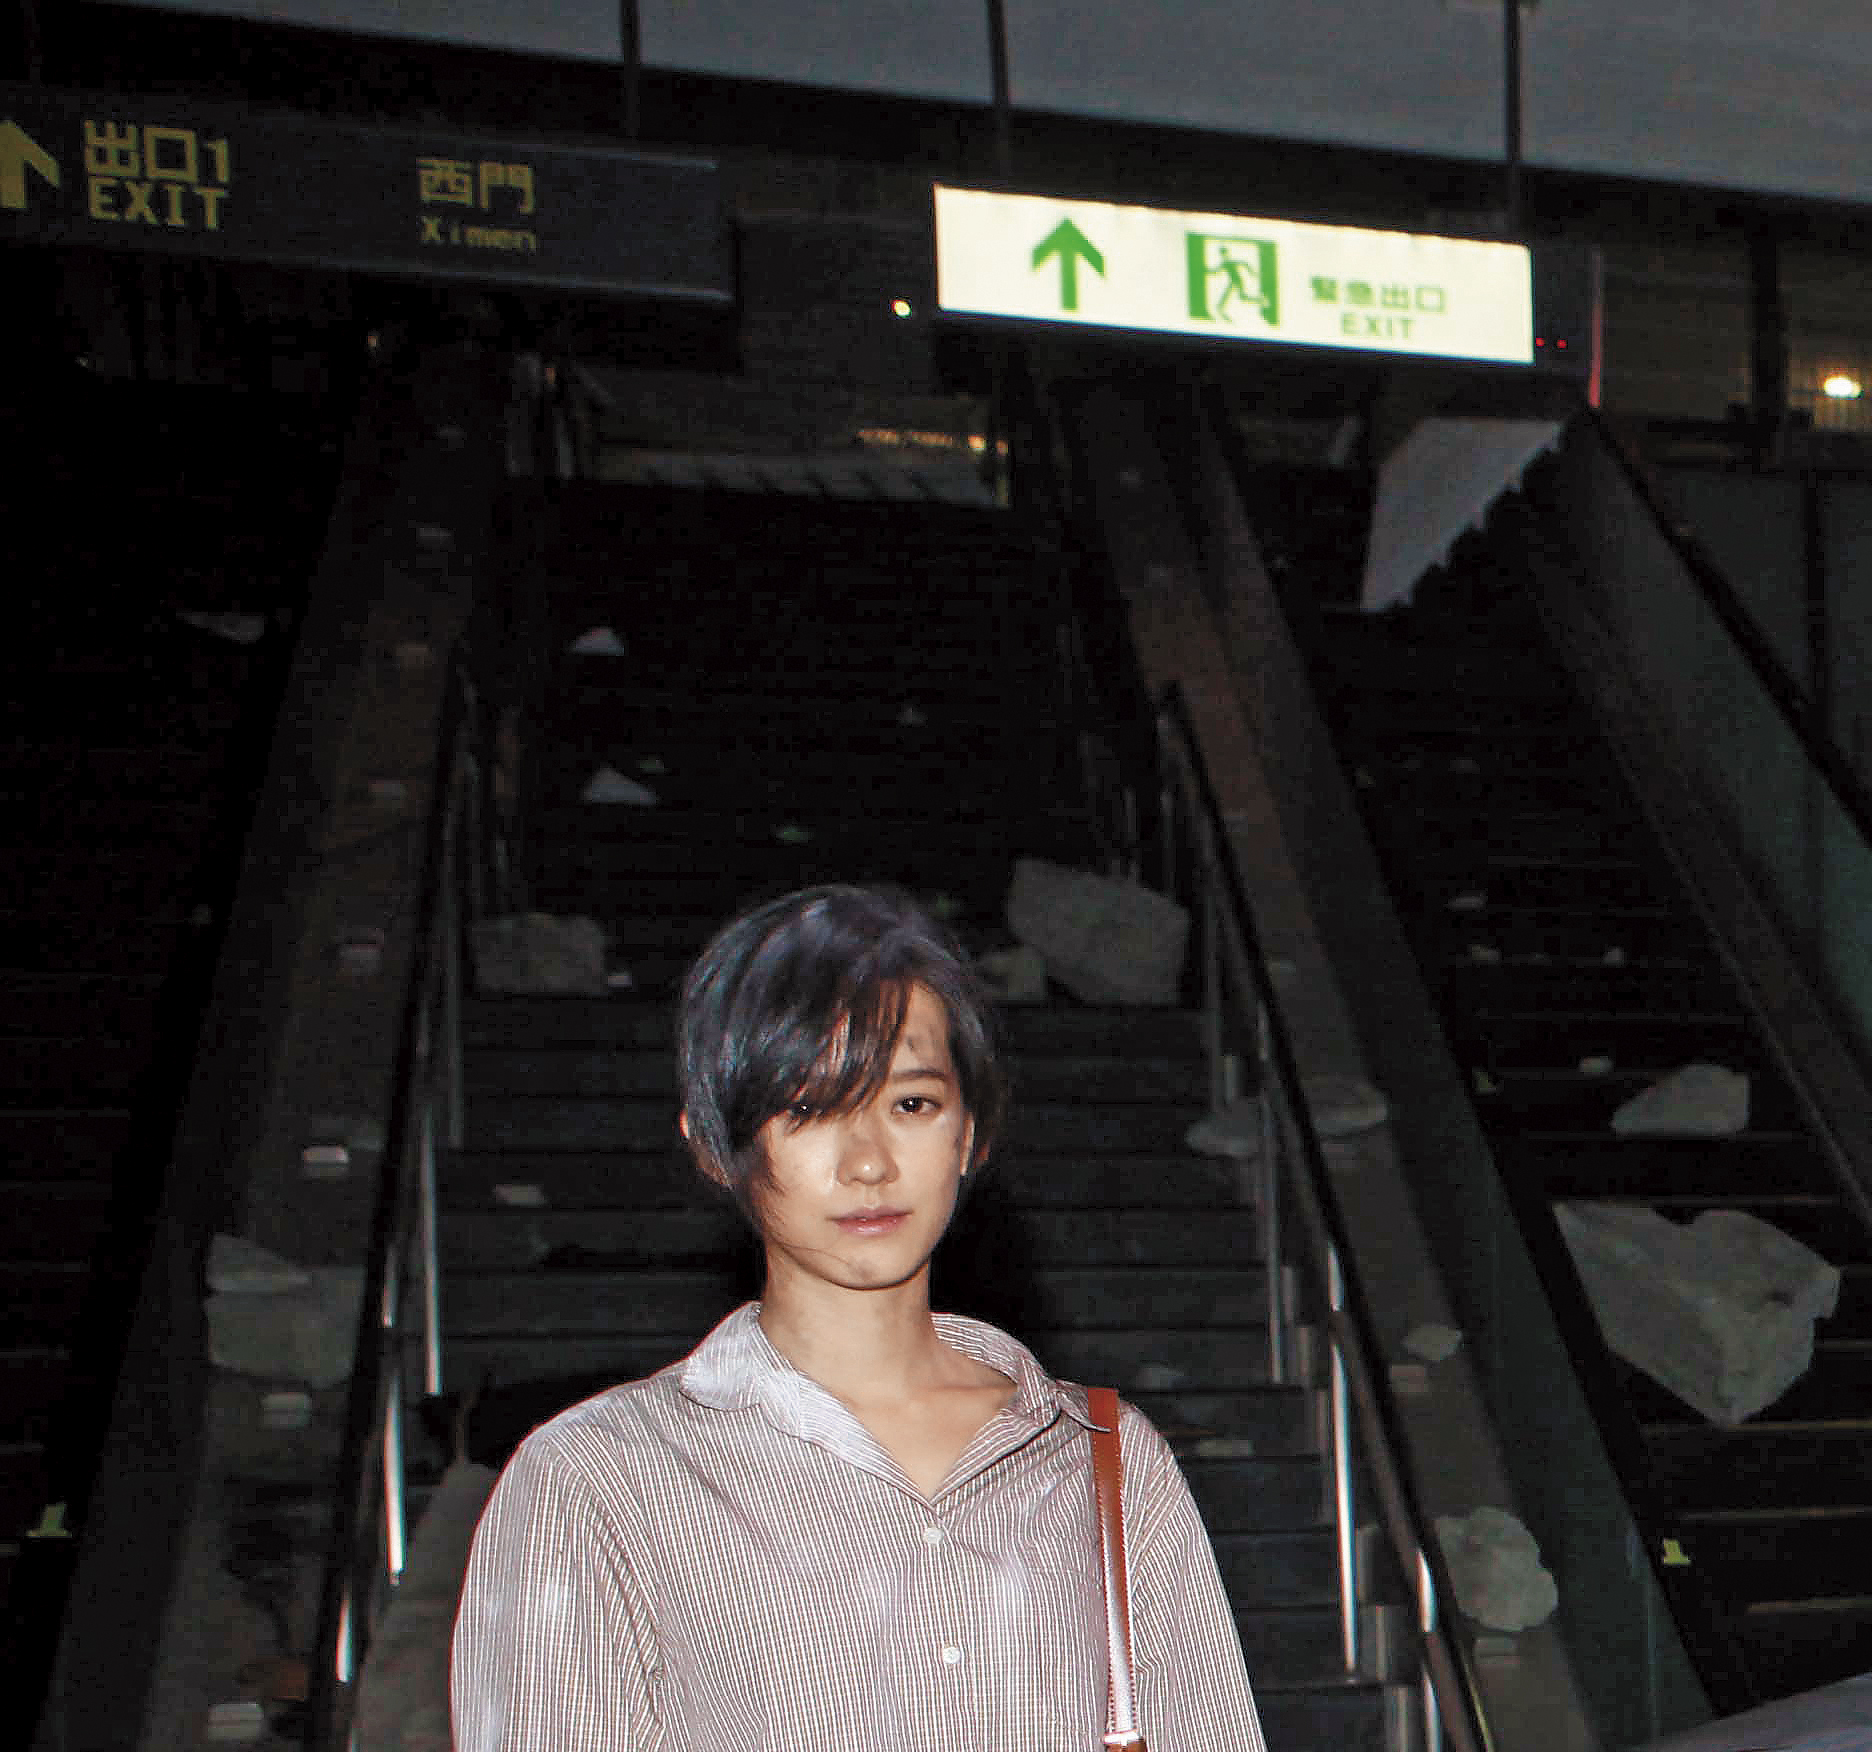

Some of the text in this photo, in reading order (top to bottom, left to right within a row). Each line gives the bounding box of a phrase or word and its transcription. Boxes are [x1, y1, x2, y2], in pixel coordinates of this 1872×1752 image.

[84, 120, 230, 182] 出口1
[88, 179, 226, 231] EXIT
[416, 157, 536, 214] 西門
[1311, 277, 1445, 313] 緊急出口
[1342, 314, 1414, 339] EXIT
